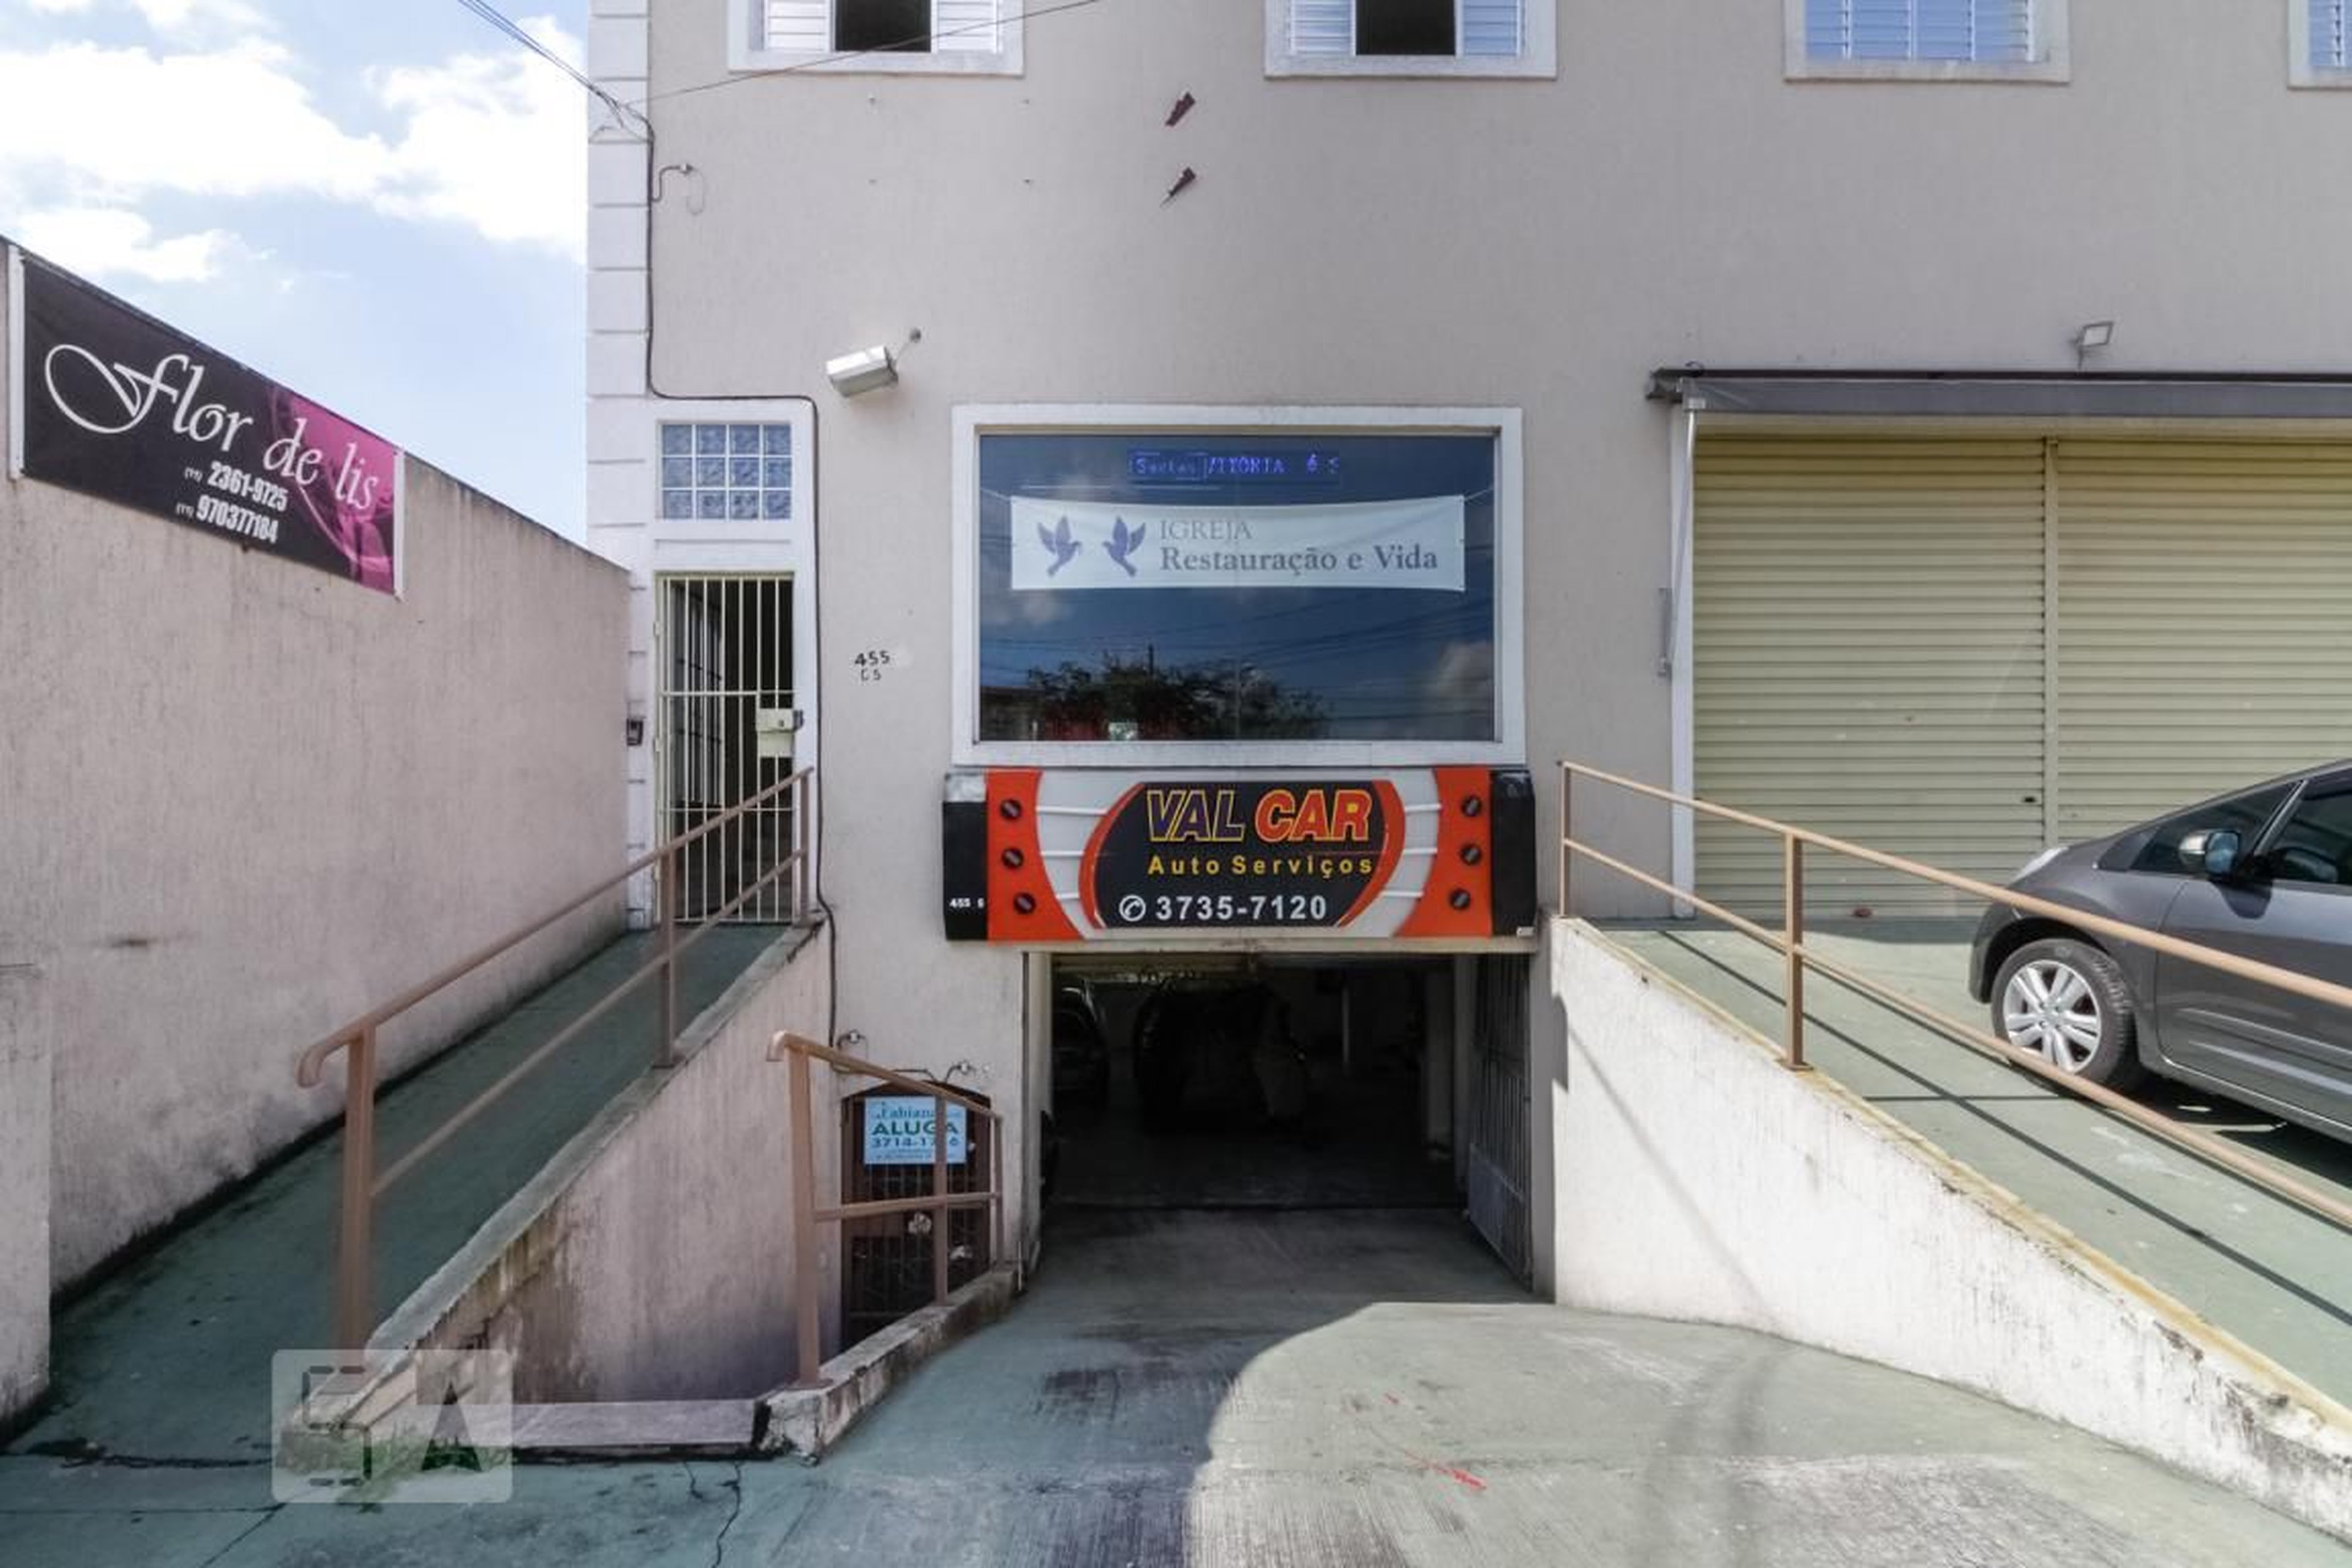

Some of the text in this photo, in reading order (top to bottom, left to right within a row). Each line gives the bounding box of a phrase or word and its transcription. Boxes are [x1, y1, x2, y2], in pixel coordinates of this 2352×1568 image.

[45, 344, 379, 511] Flor de lis
[206, 460, 289, 512] 2361-9725
[195, 494, 279, 543] 970377184
[1160, 519, 1253, 541] IGREJA
[1159, 544, 1438, 576] Restauração e Vida
[854, 650, 889, 666] 455
[1147, 789, 1373, 843] VAL CAR
[1147, 854, 1373, 878] Auto Serviços
[1155, 894, 1327, 920] 3735-7120
[872, 1121, 959, 1136] ALUGA
